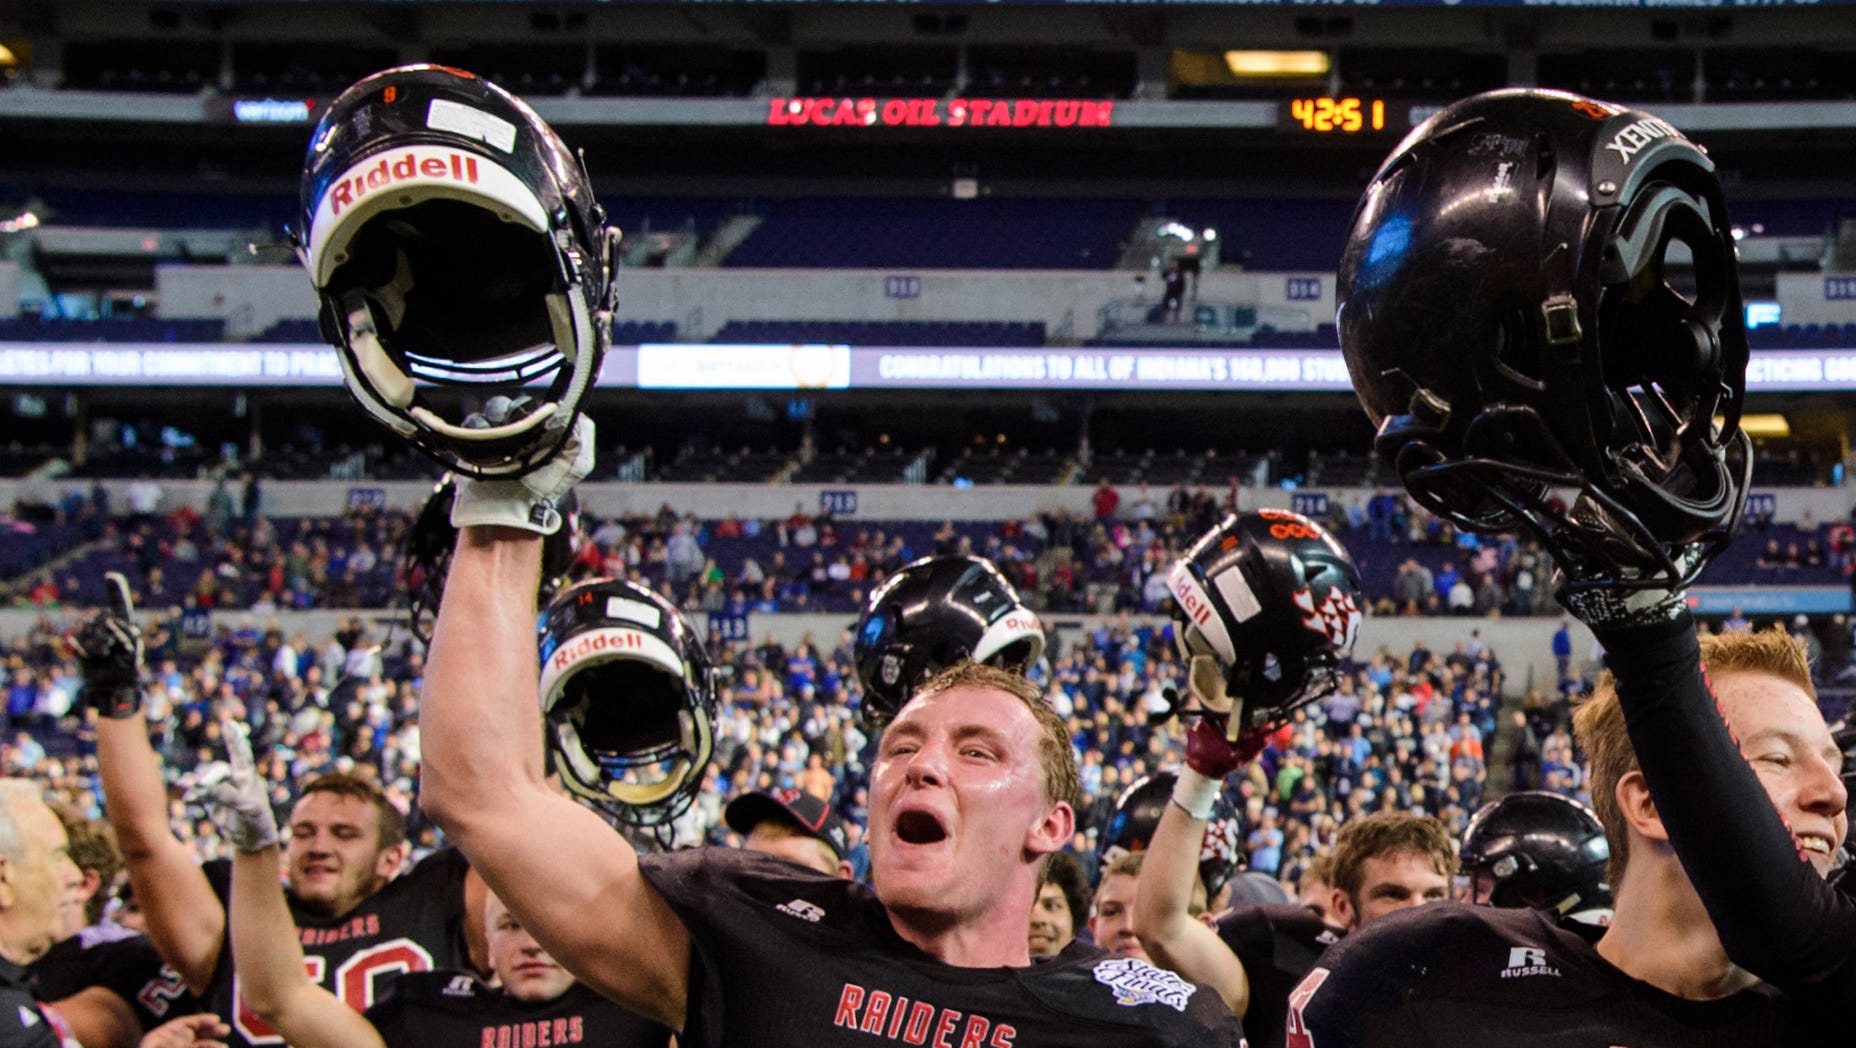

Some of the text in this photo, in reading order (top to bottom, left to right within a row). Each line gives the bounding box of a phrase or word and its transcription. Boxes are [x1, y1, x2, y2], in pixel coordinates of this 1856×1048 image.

[767, 100, 1112, 128] LUCAS OIL STADIUM
[1292, 98, 1384, 131] 42:51
[331, 154, 478, 215] Riddell
[879, 355, 1045, 379] CONGRATULATIONS
[1048, 355, 1072, 379] TO
[1074, 356, 1107, 379] ALL
[1110, 356, 1135, 379] OF
[555, 633, 642, 671] Riddell
[300, 913, 380, 946] AIDERS
[1500, 965, 1563, 978] RUSSELL
